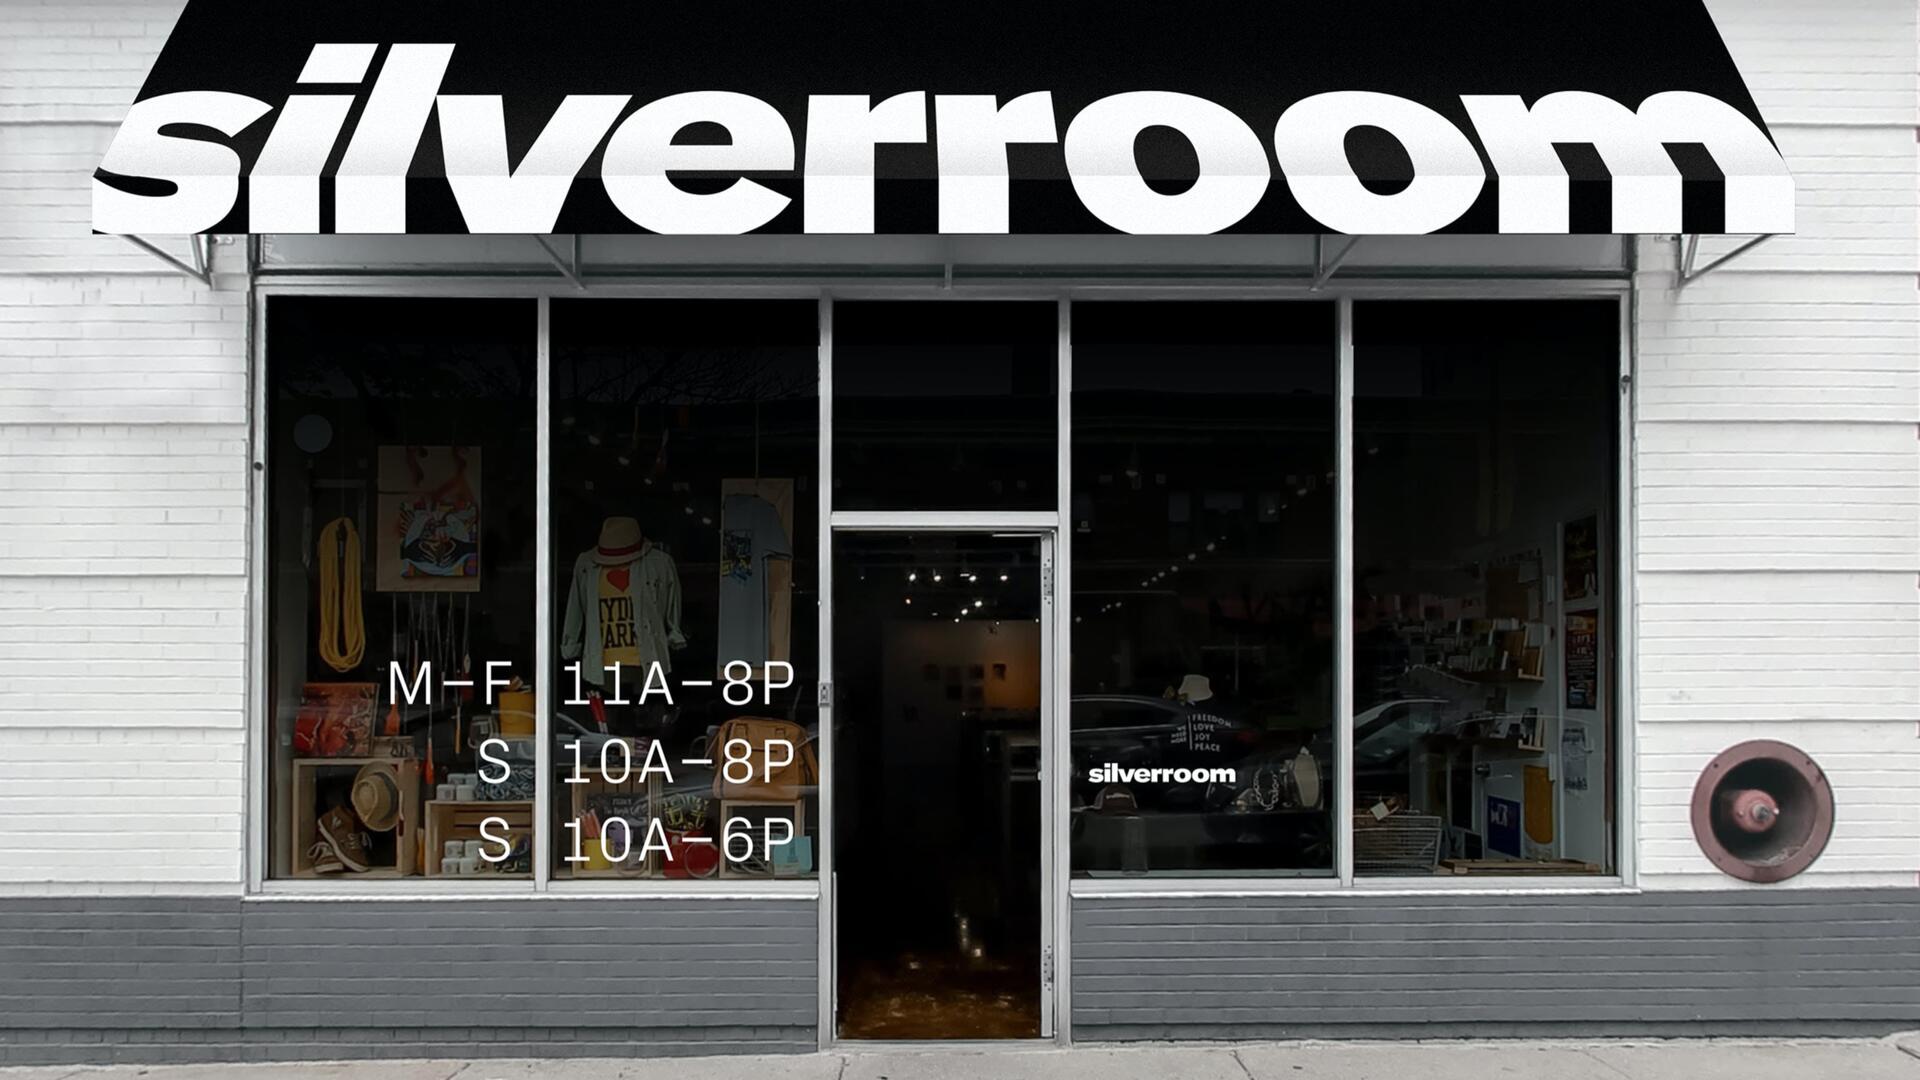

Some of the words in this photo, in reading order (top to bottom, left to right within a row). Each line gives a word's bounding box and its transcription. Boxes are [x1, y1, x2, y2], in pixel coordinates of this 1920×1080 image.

[92, 43, 1795, 234] silverroom
[391, 661, 511, 704] M-F
[565, 661, 794, 704] 11A-8P
[1192, 713, 1232, 728] FREEDOM
[1193, 723, 1215, 732] LOVE
[1194, 732, 1211, 741] JOY
[1194, 742, 1221, 752] PEACE
[479, 739, 510, 784] S
[565, 739, 794, 784] 10A-8P
[1088, 763, 1236, 783] silverroom
[479, 818, 510, 862] S
[565, 818, 794, 862] 10A-6P
